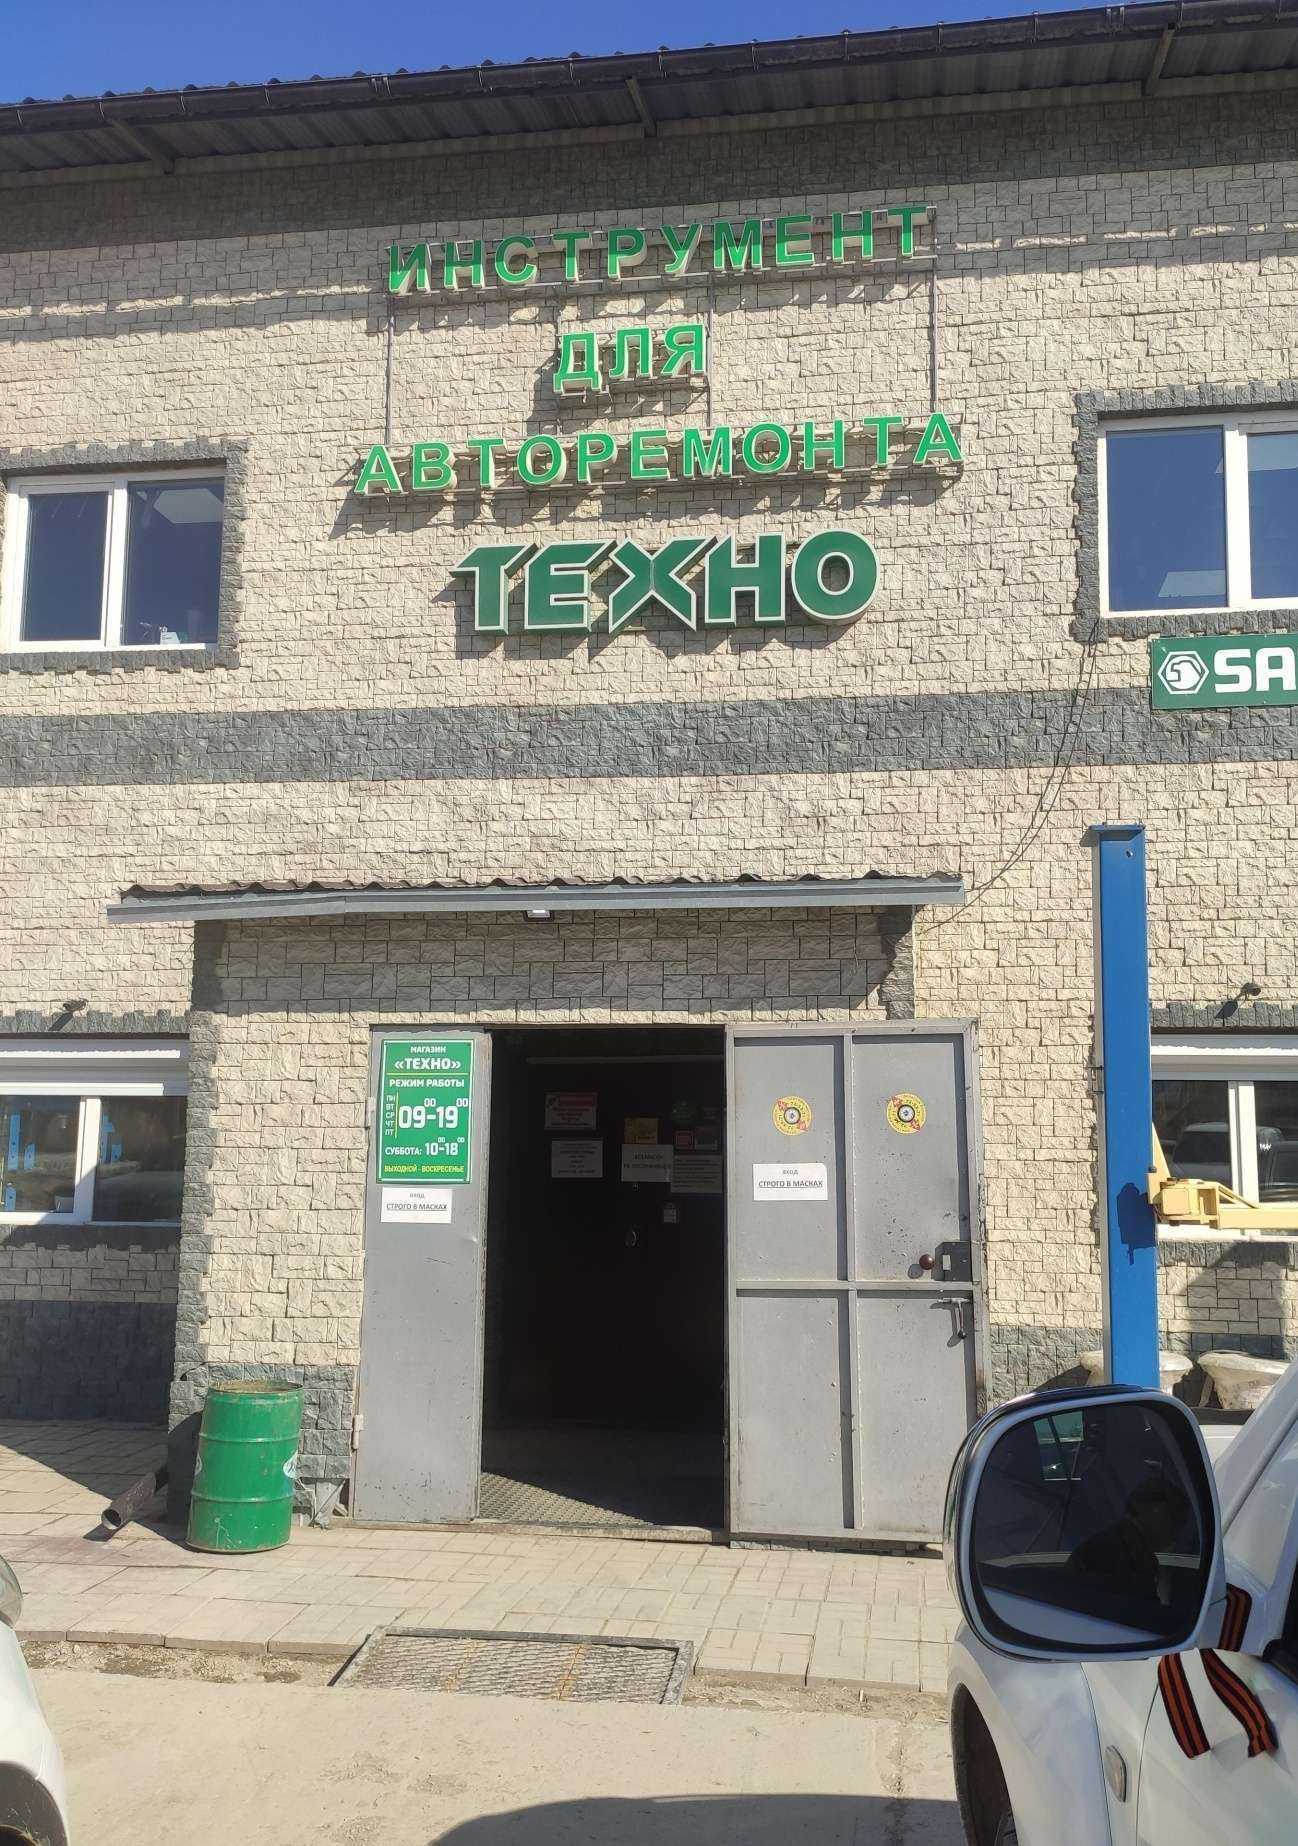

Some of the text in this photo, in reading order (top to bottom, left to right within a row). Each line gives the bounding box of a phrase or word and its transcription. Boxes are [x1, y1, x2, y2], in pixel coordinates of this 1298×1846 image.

[388, 205, 930, 293] ИНСТРУМЕНТ
[553, 323, 707, 394] ДЛЯ
[355, 412, 965, 495] АВТОРЕМОНТА
[449, 530, 881, 635] ТЕХНО
[410, 1045, 447, 1054] МАГАЗИН
[394, 1057, 461, 1070] «ТЕХНО»
[389, 1079, 465, 1088] РЕЖИМ РАБОТЫ
[385, 1147, 422, 1155] СУББОТА:
[384, 1164, 417, 1173] ВЫХОДНОЙ
[421, 1165, 465, 1173] ВОСКРЕСЕНЬЕ
